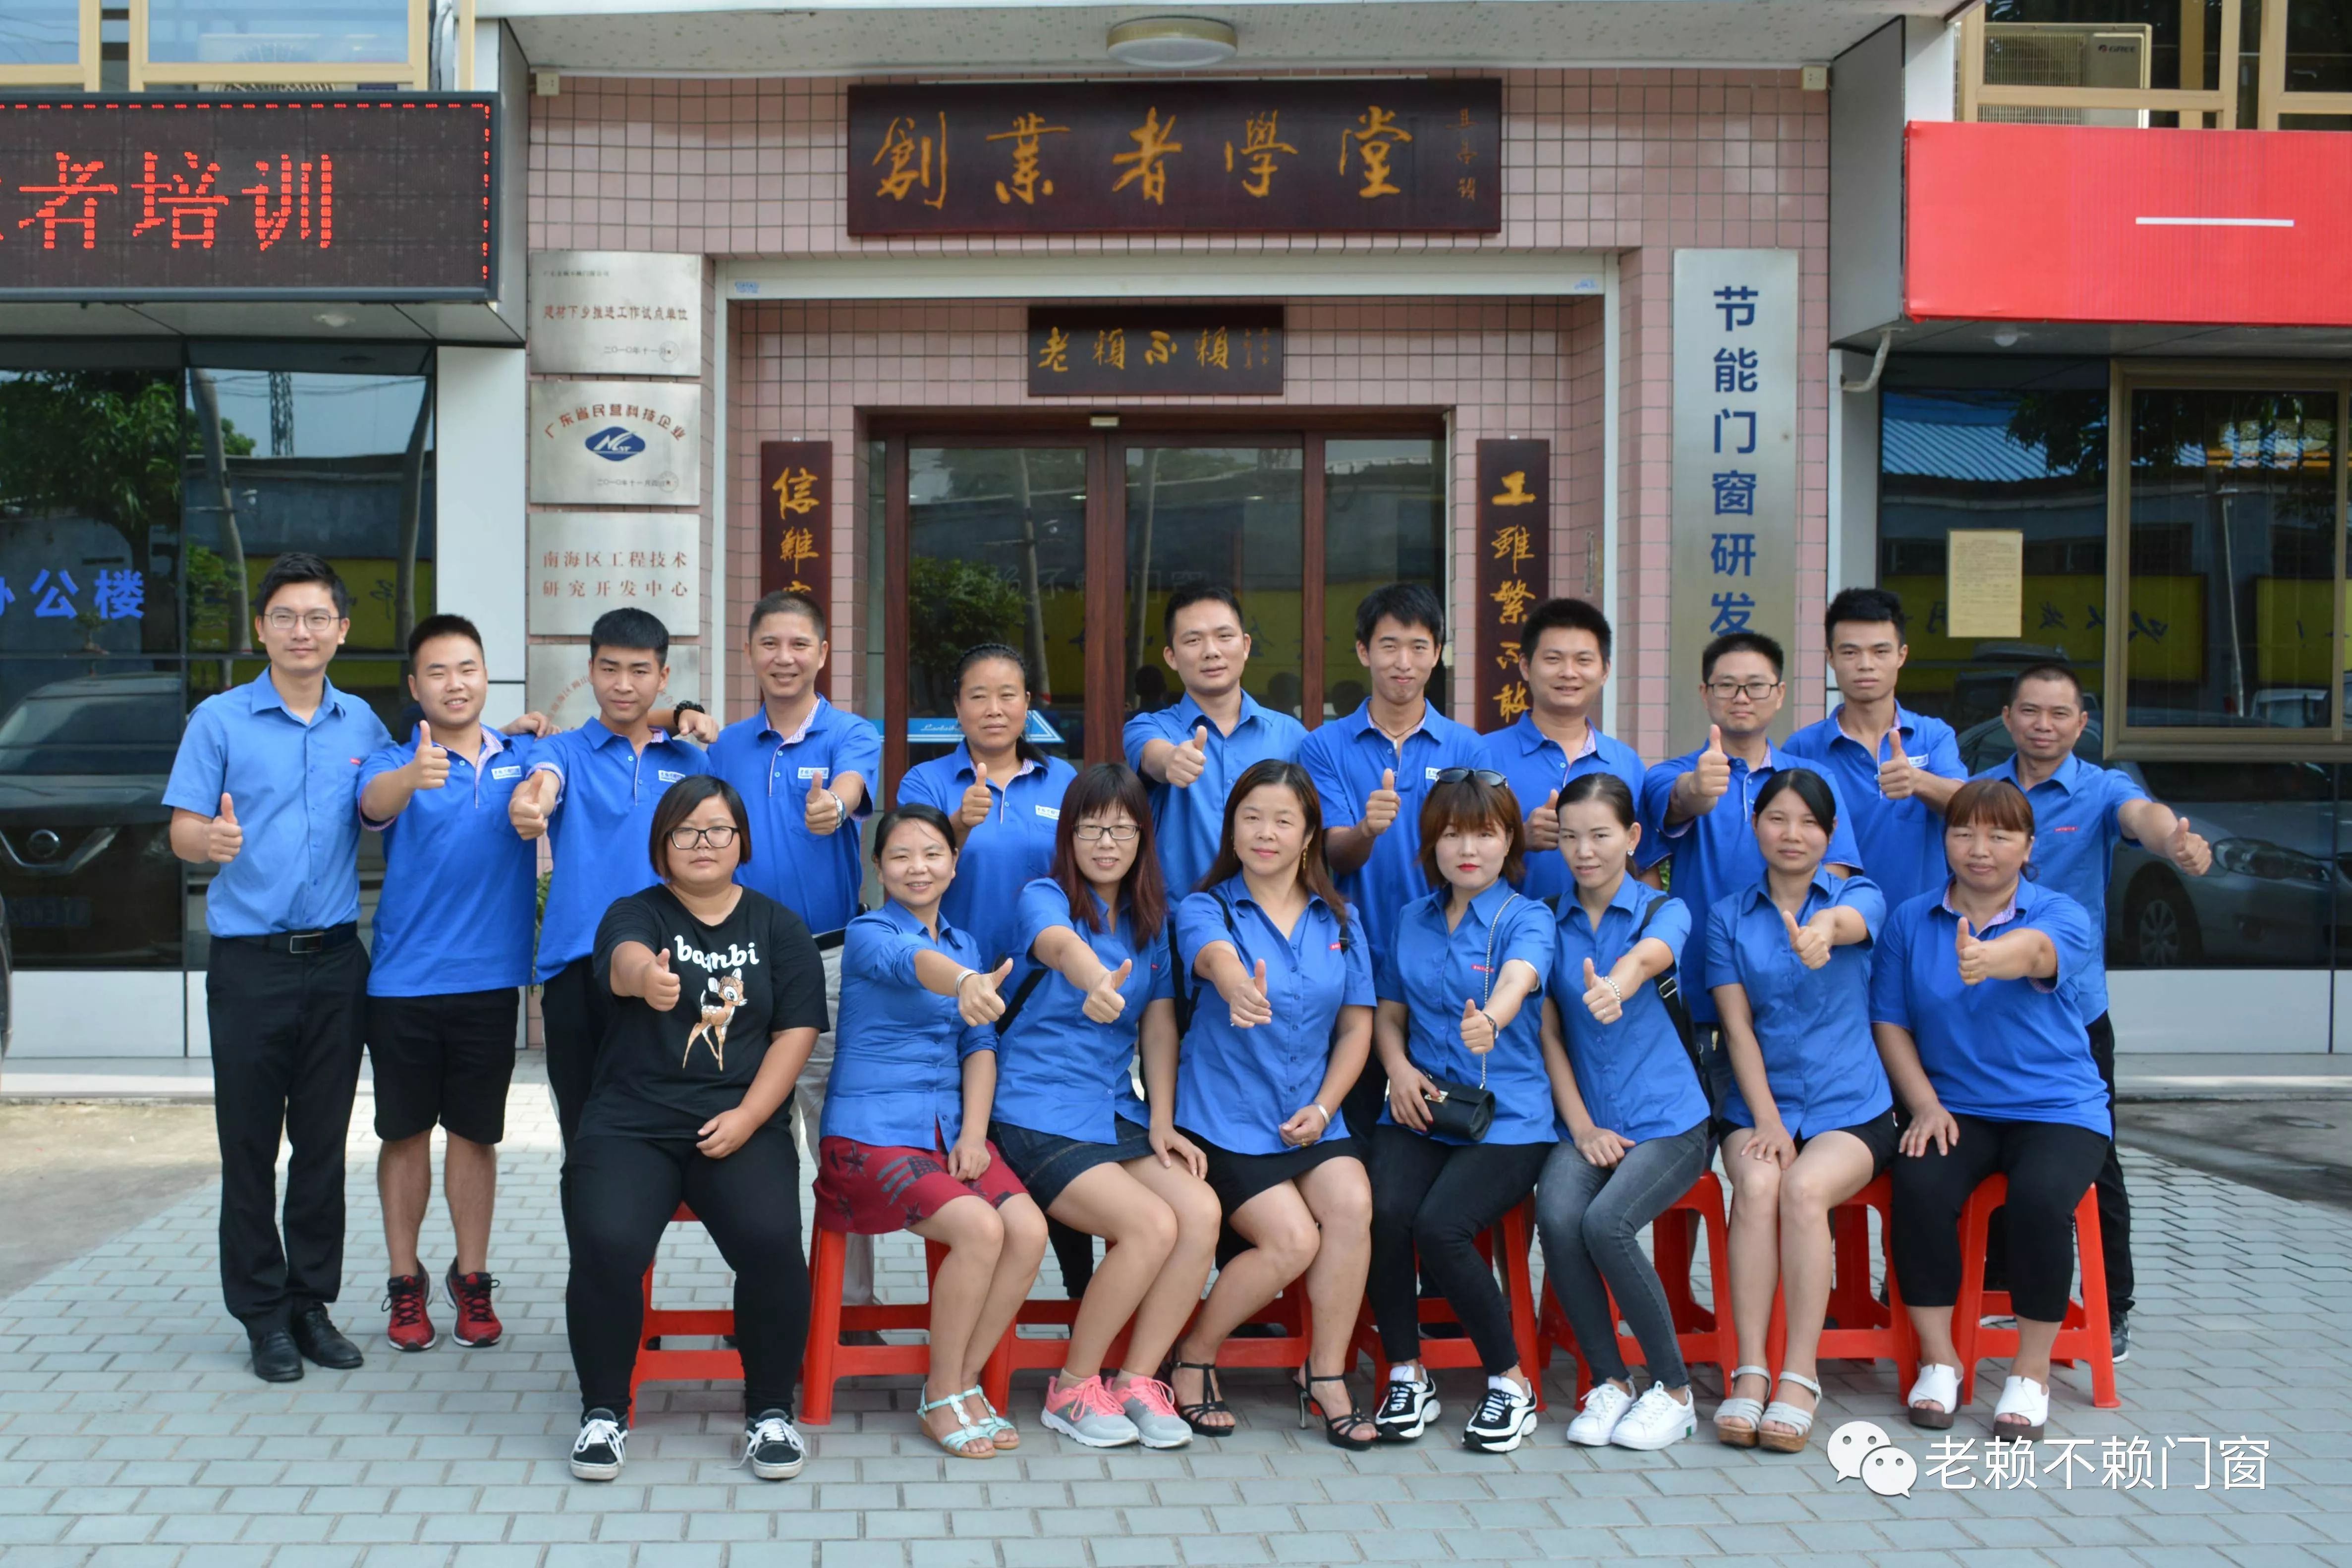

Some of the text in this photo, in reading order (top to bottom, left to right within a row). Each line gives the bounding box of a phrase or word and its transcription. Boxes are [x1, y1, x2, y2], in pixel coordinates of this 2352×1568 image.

[0, 151, 334, 250] 者培训
[543, 304, 688, 321] 建材下乡推进工作试点单位
[544, 403, 686, 441] 广东省民营科技企业
[1710, 285, 1759, 636] 节能门窗研发
[543, 551, 688, 568] 南海区工程技术
[543, 580, 688, 597] 研究开发中心
[674, 934, 760, 973] bambi
